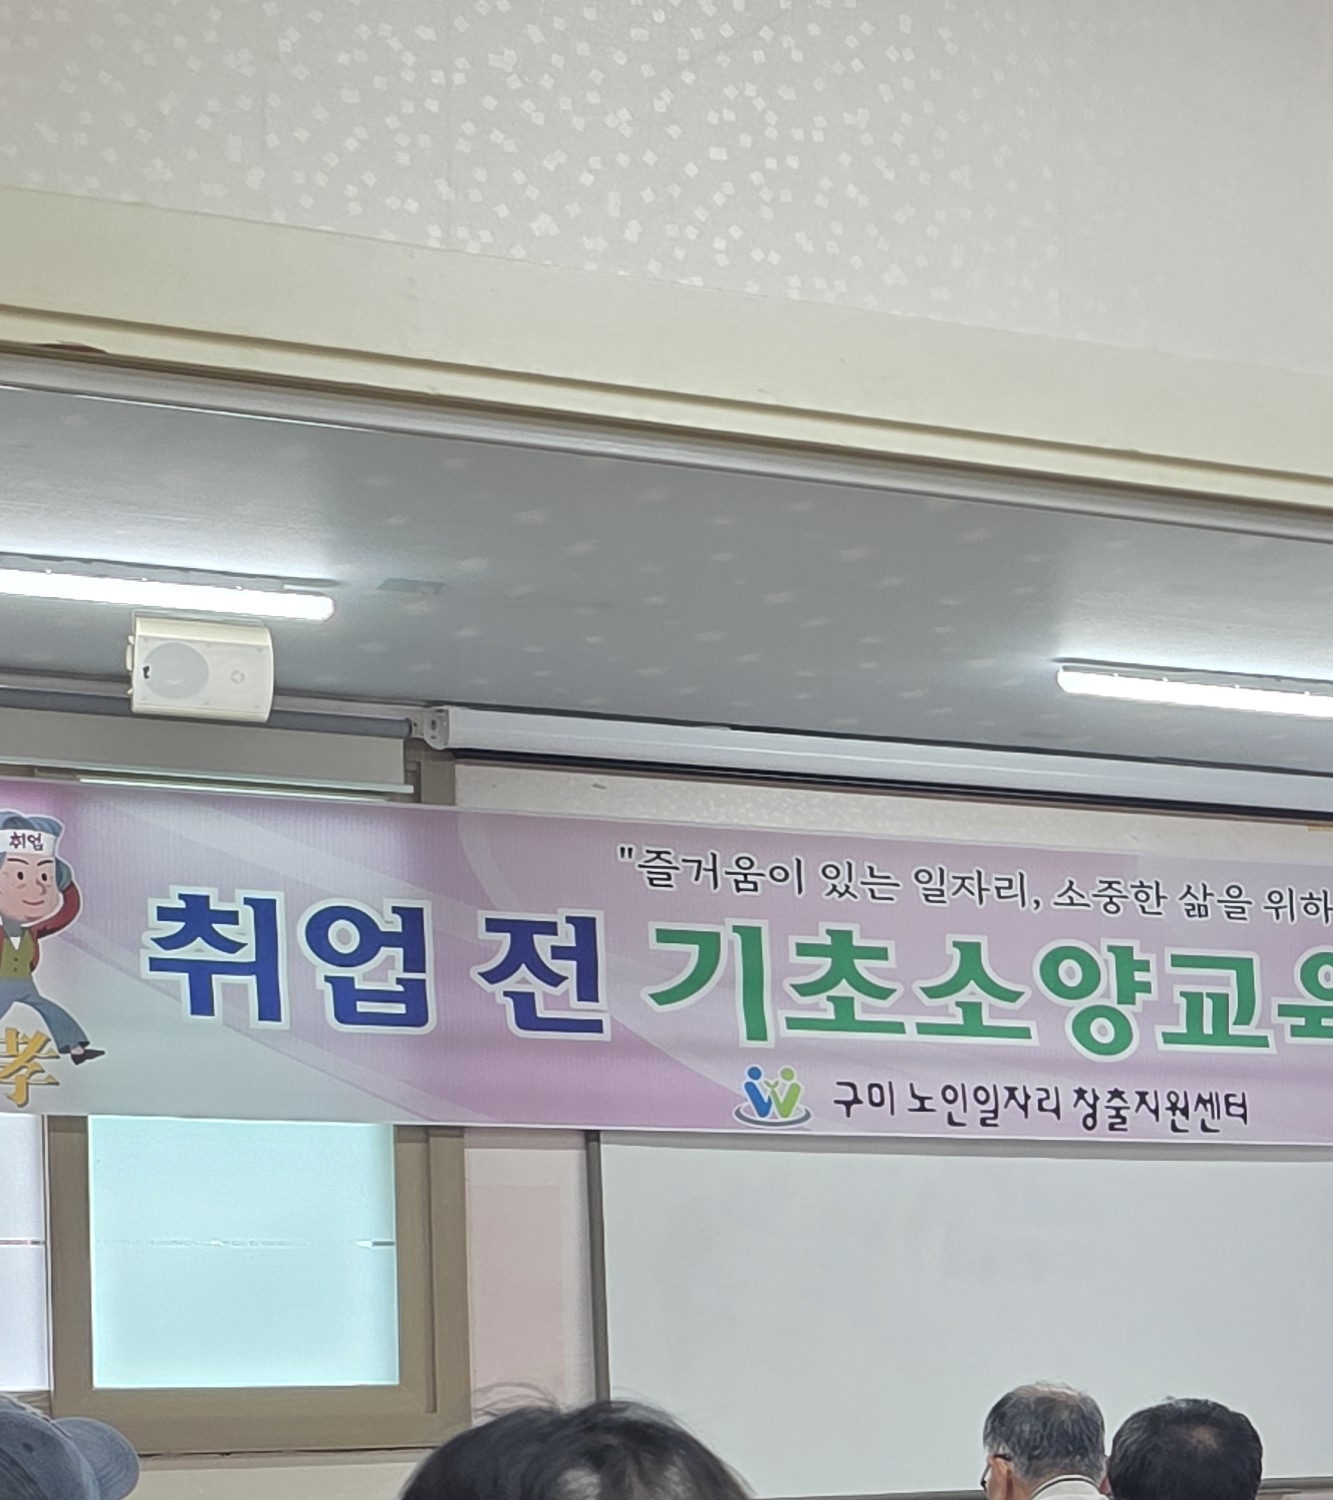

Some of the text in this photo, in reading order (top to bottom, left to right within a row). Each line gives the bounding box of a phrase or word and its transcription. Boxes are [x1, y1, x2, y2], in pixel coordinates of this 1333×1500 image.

[9, 830, 43, 851] 취업
[619, 846, 804, 892] "즐거움이
[821, 862, 901, 901] 있는
[915, 866, 1042, 910] 일자리,
[1053, 878, 1168, 918] 소중한
[1178, 882, 1253, 921] 삶을
[148, 893, 429, 1027] 취업
[478, 914, 603, 1033] 전
[0, 1027, 60, 1108] 孝
[833, 1080, 1248, 1133] 구미 노인일자리 창출지원센터
